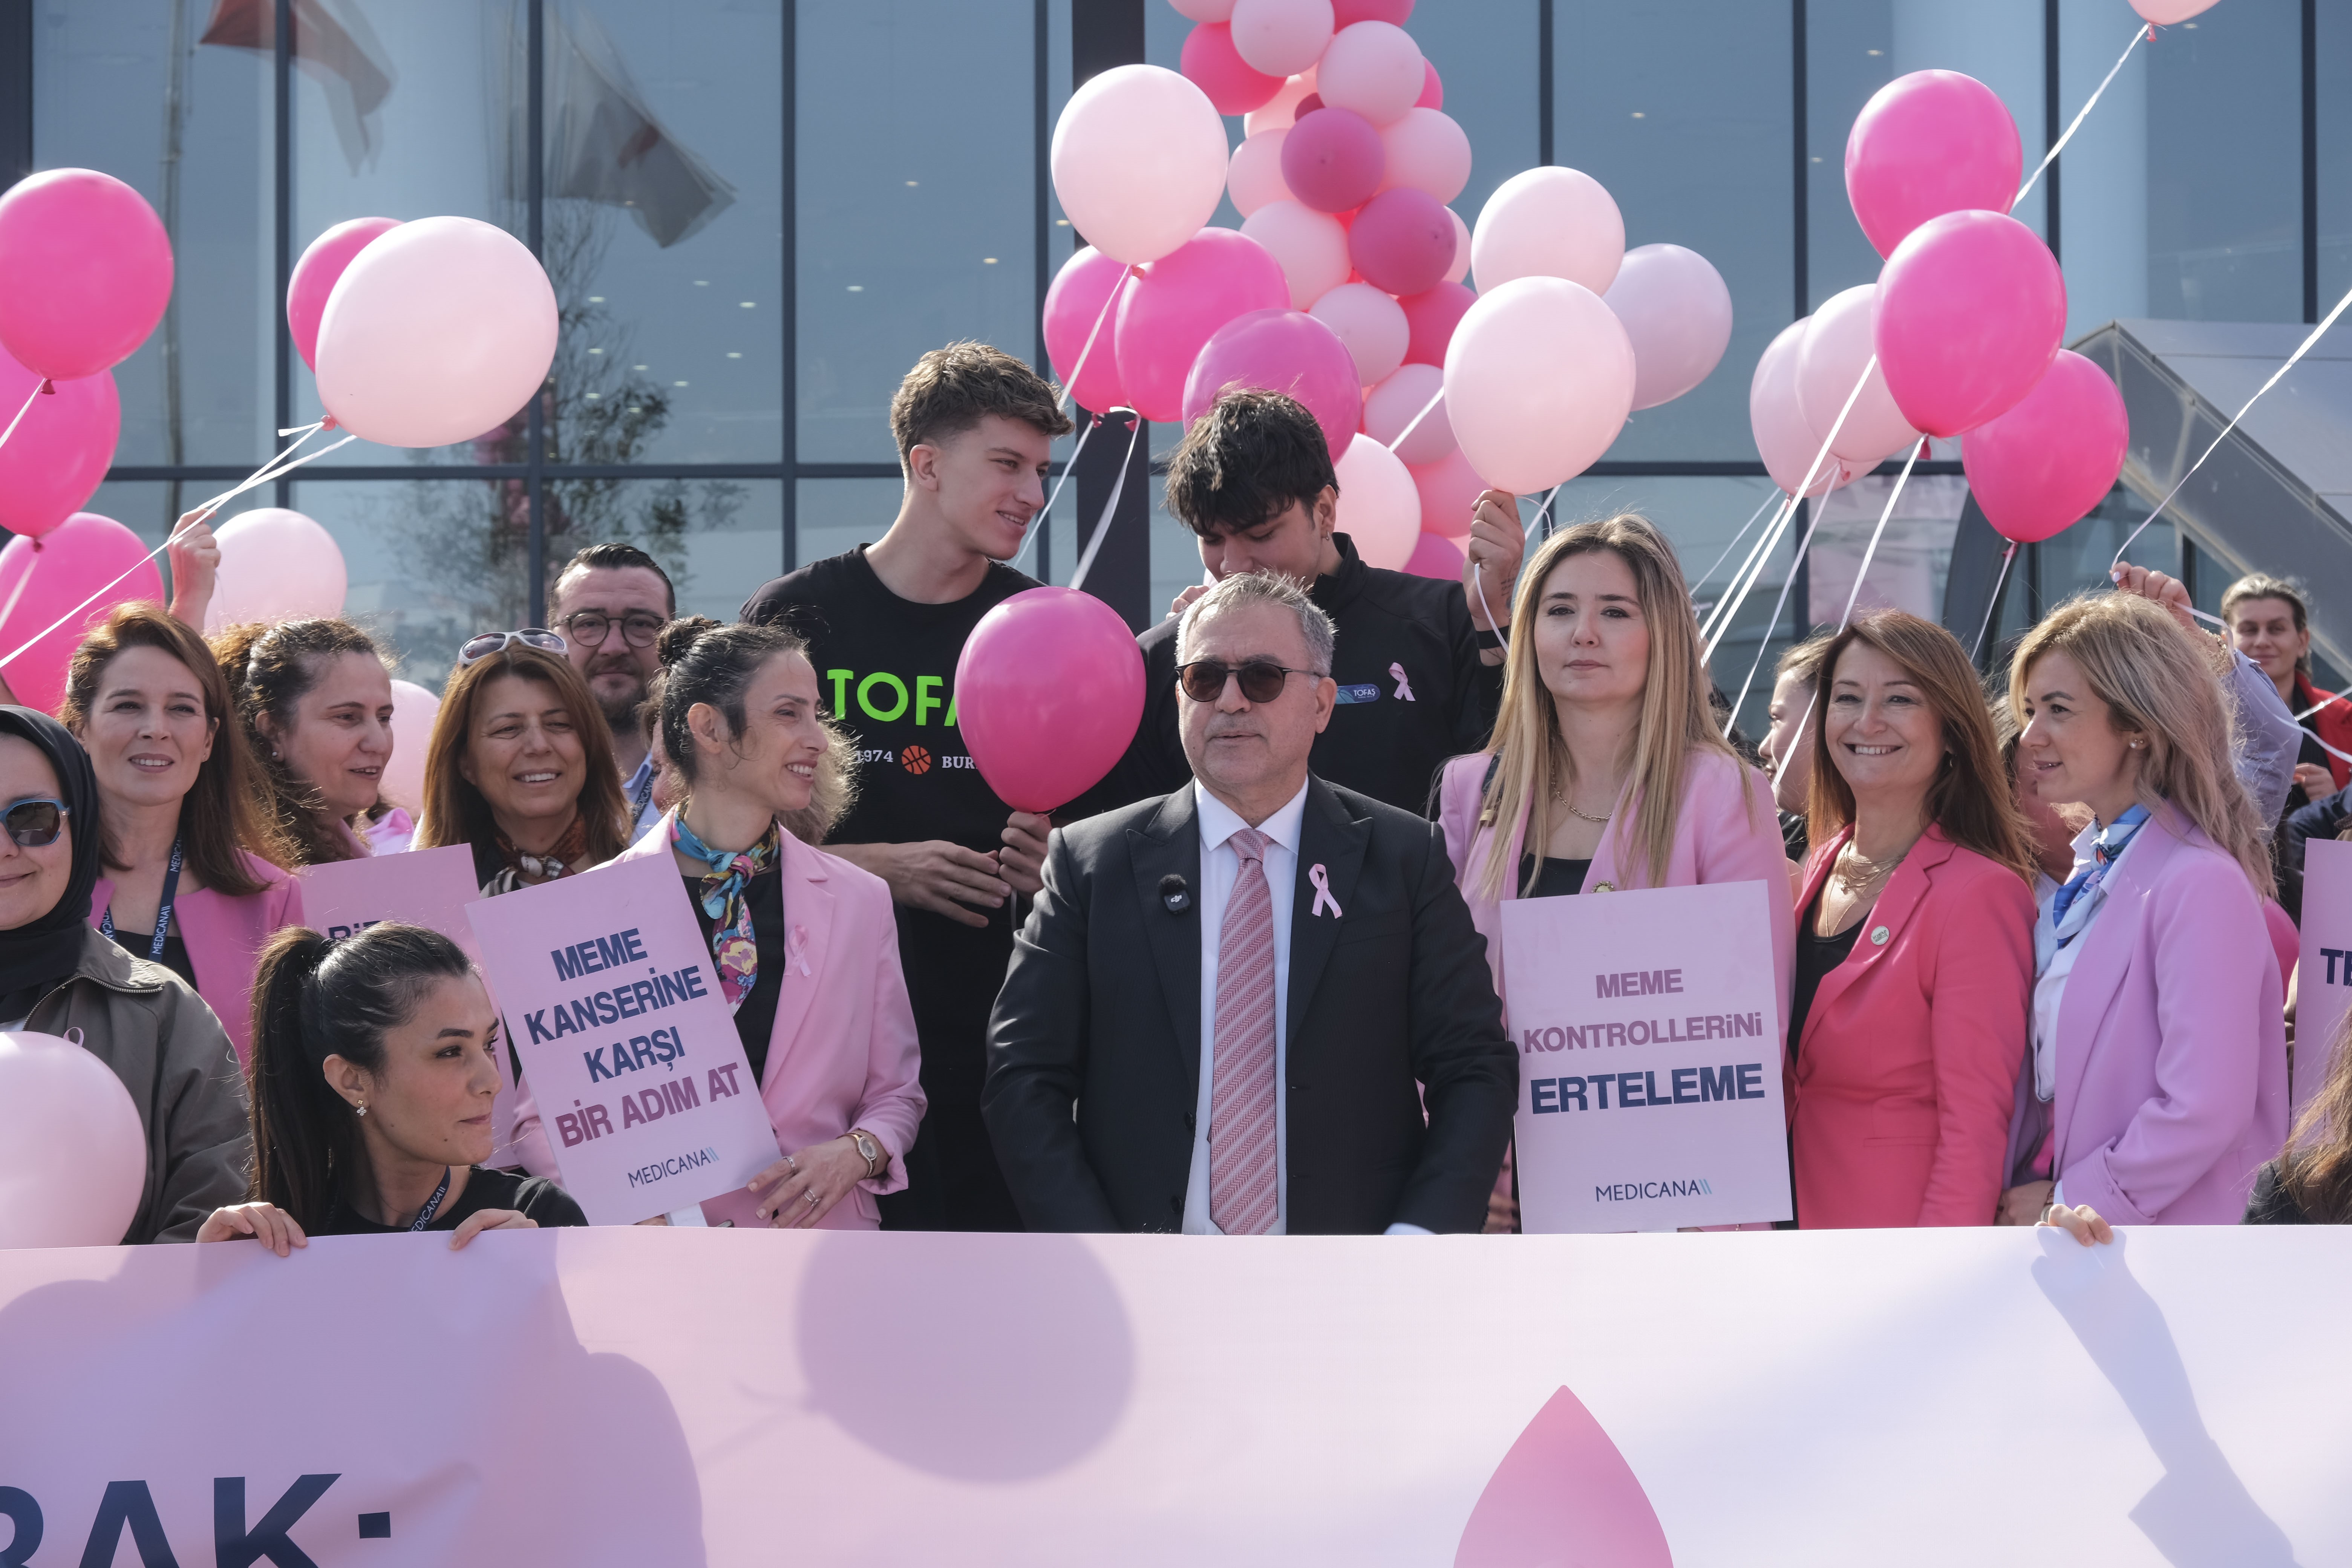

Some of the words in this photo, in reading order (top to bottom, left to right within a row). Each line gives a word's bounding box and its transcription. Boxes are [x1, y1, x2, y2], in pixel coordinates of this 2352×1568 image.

[856, 750, 894, 763] 1974
[942, 756, 977, 769] BUR
[152, 910, 170, 954] MEDICANA
[550, 928, 648, 981] MEME
[524, 966, 708, 1044] KANSERİNE
[1596, 969, 1683, 998] MEME
[583, 1026, 686, 1083] KARŞI
[555, 1100, 614, 1147] BİR
[621, 1076, 701, 1130] ADIM
[708, 1063, 740, 1101] AT
[1531, 1063, 1765, 1114] ERTELEME
[628, 1149, 710, 1188] MEDICANA
[1596, 1179, 1701, 1202] MEDICANA
